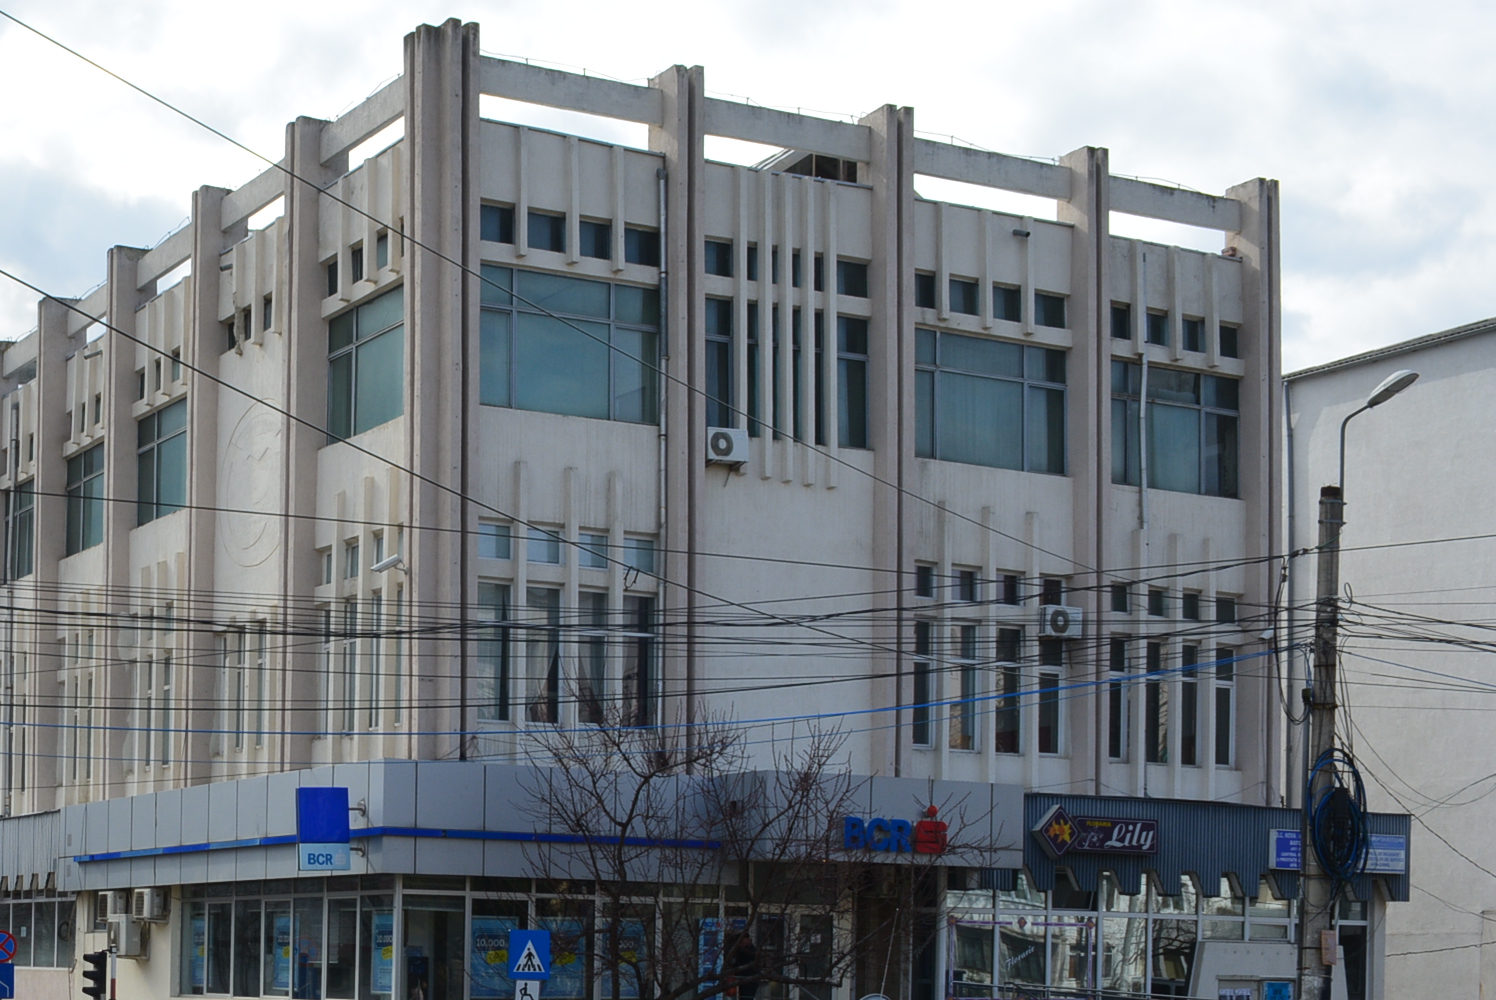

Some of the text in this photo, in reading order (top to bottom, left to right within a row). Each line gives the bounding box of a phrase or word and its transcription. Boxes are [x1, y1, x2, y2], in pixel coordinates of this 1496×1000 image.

[844, 816, 912, 853] BCR
[1104, 822, 1155, 851] Lily
[307, 852, 334, 866] BCR
